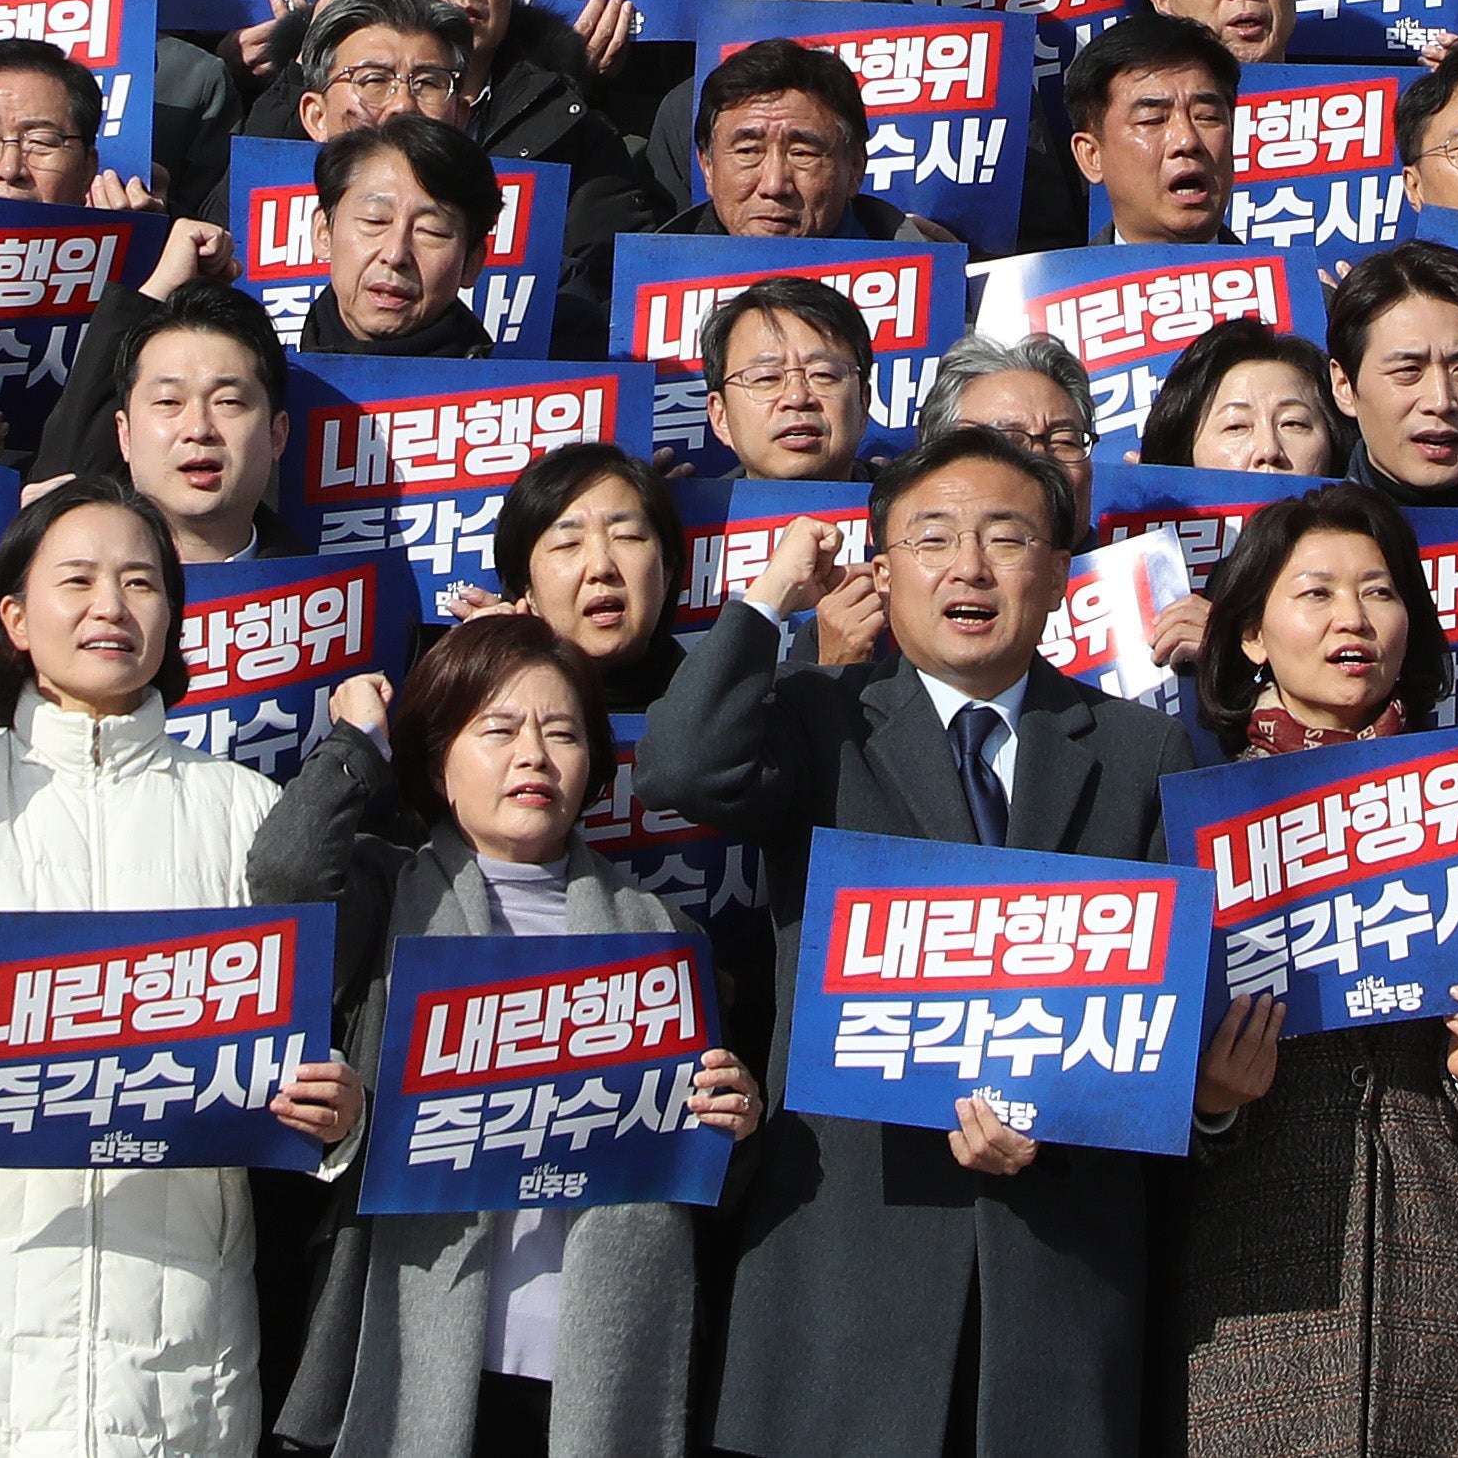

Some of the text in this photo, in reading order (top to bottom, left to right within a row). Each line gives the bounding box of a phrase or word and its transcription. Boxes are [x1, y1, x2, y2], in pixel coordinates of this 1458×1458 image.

[322, 388, 604, 491] 내란행위
[842, 891, 1159, 979] 내란행위
[421, 960, 697, 1079] 내란행위
[834, 993, 1177, 1081] 즉각수사!
[1345, 984, 1424, 1018] 민주당
[89, 1140, 169, 1163] 민주당
[519, 1173, 589, 1200] 민주당
